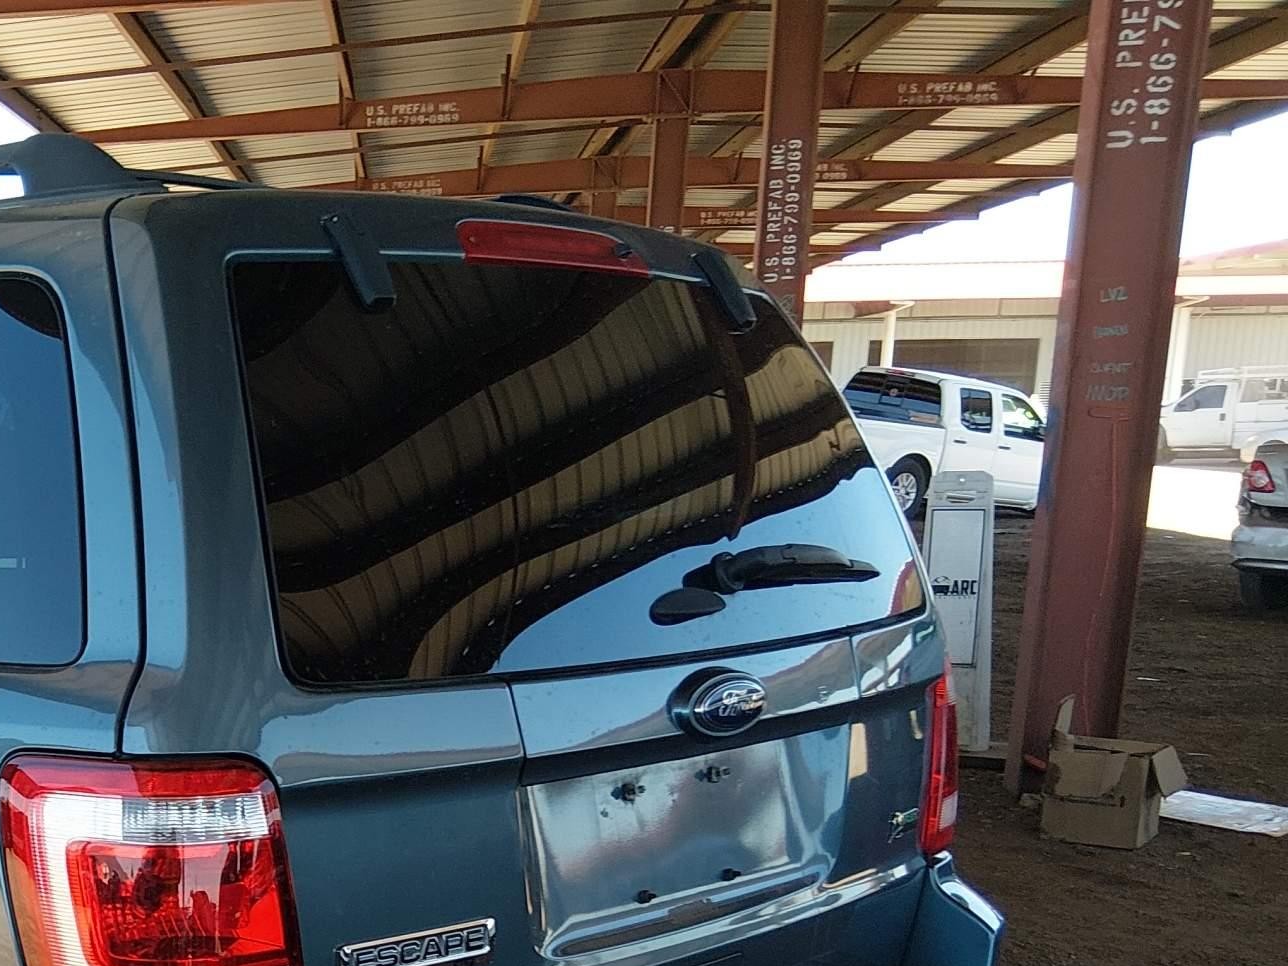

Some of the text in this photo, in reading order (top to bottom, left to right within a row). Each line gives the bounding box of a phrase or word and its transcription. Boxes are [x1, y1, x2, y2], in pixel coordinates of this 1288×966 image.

[392, 103, 434, 115] PREFAB
[926, 82, 973, 93] PREFAB
[1105, 0, 1152, 149] U.S. PRE
[763, 138, 787, 283] U.S. PREFAB INC.
[780, 139, 802, 281] 1-866-799-0969
